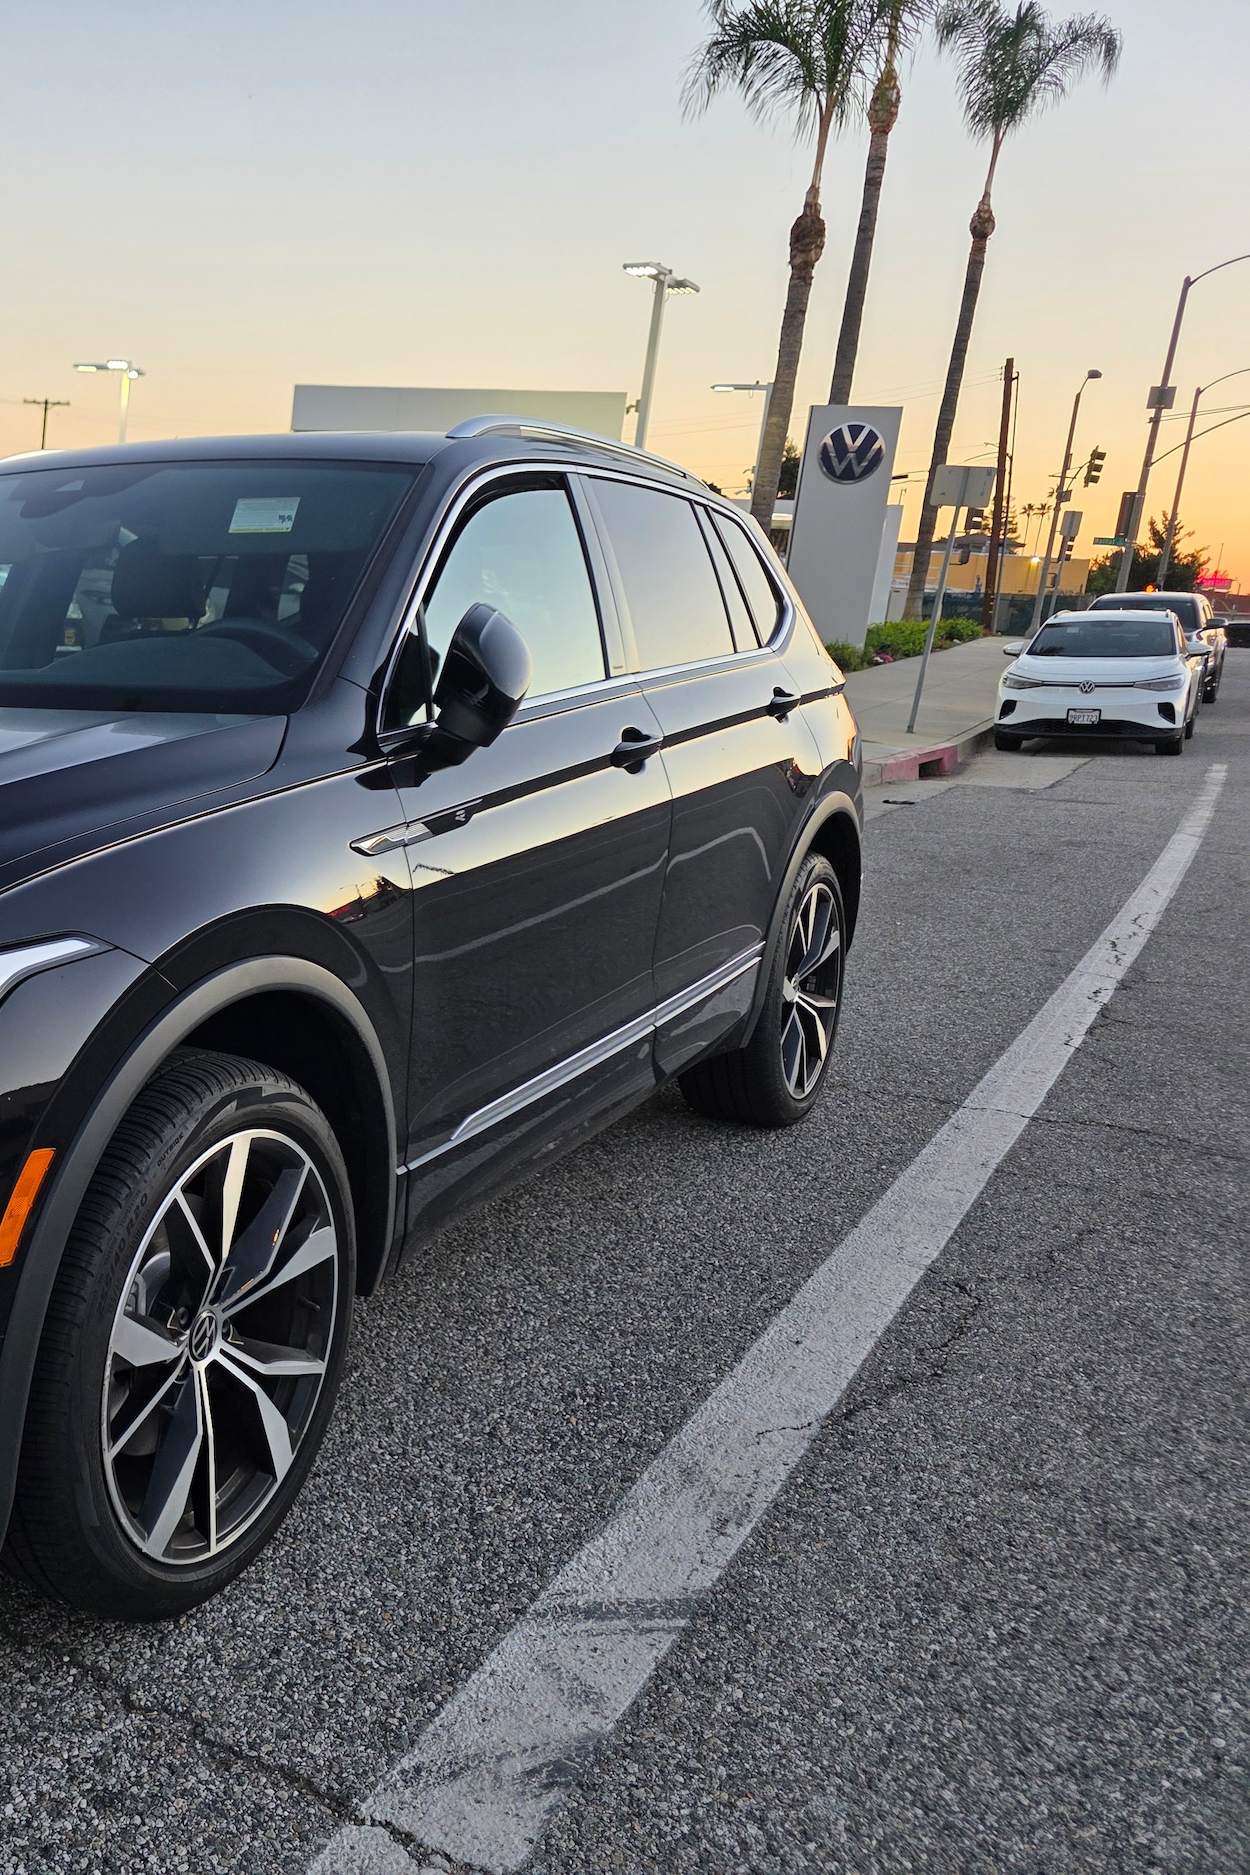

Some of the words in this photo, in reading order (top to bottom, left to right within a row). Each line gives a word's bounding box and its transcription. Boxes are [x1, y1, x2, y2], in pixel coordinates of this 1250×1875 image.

[817, 421, 886, 485] VW
[1079, 680, 1096, 694] VW
[157, 1132, 184, 1167] OUTSIDE
[125, 1192, 148, 1235] R20
